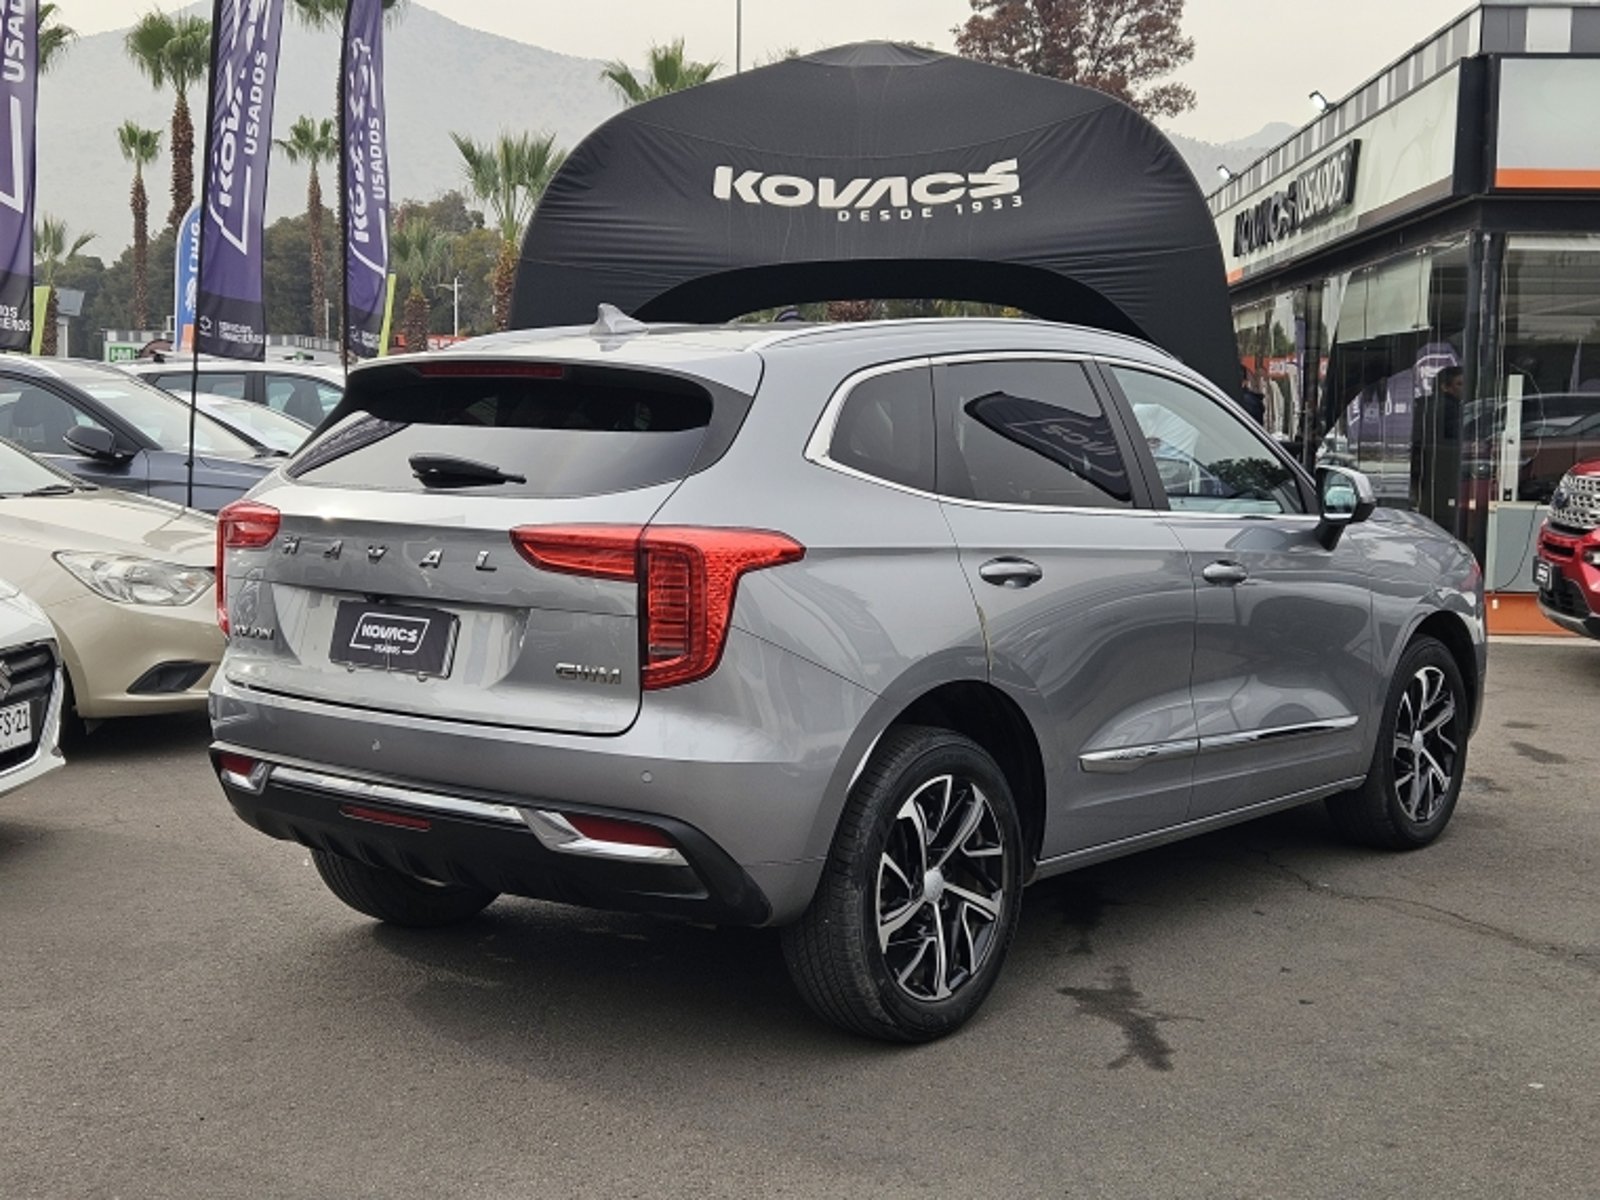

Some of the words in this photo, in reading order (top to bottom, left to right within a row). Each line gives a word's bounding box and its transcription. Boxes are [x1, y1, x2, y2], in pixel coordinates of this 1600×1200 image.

[243, 50, 268, 155] USADOS
[368, 117, 386, 201] USADOS
[713, 158, 1020, 209] KOVACS
[837, 207, 934, 222] DESDE
[954, 195, 1024, 215] 1933
[282, 536, 498, 572] HAVAL
[361, 623, 418, 643] KOVACS
[555, 662, 621, 684] GWM
